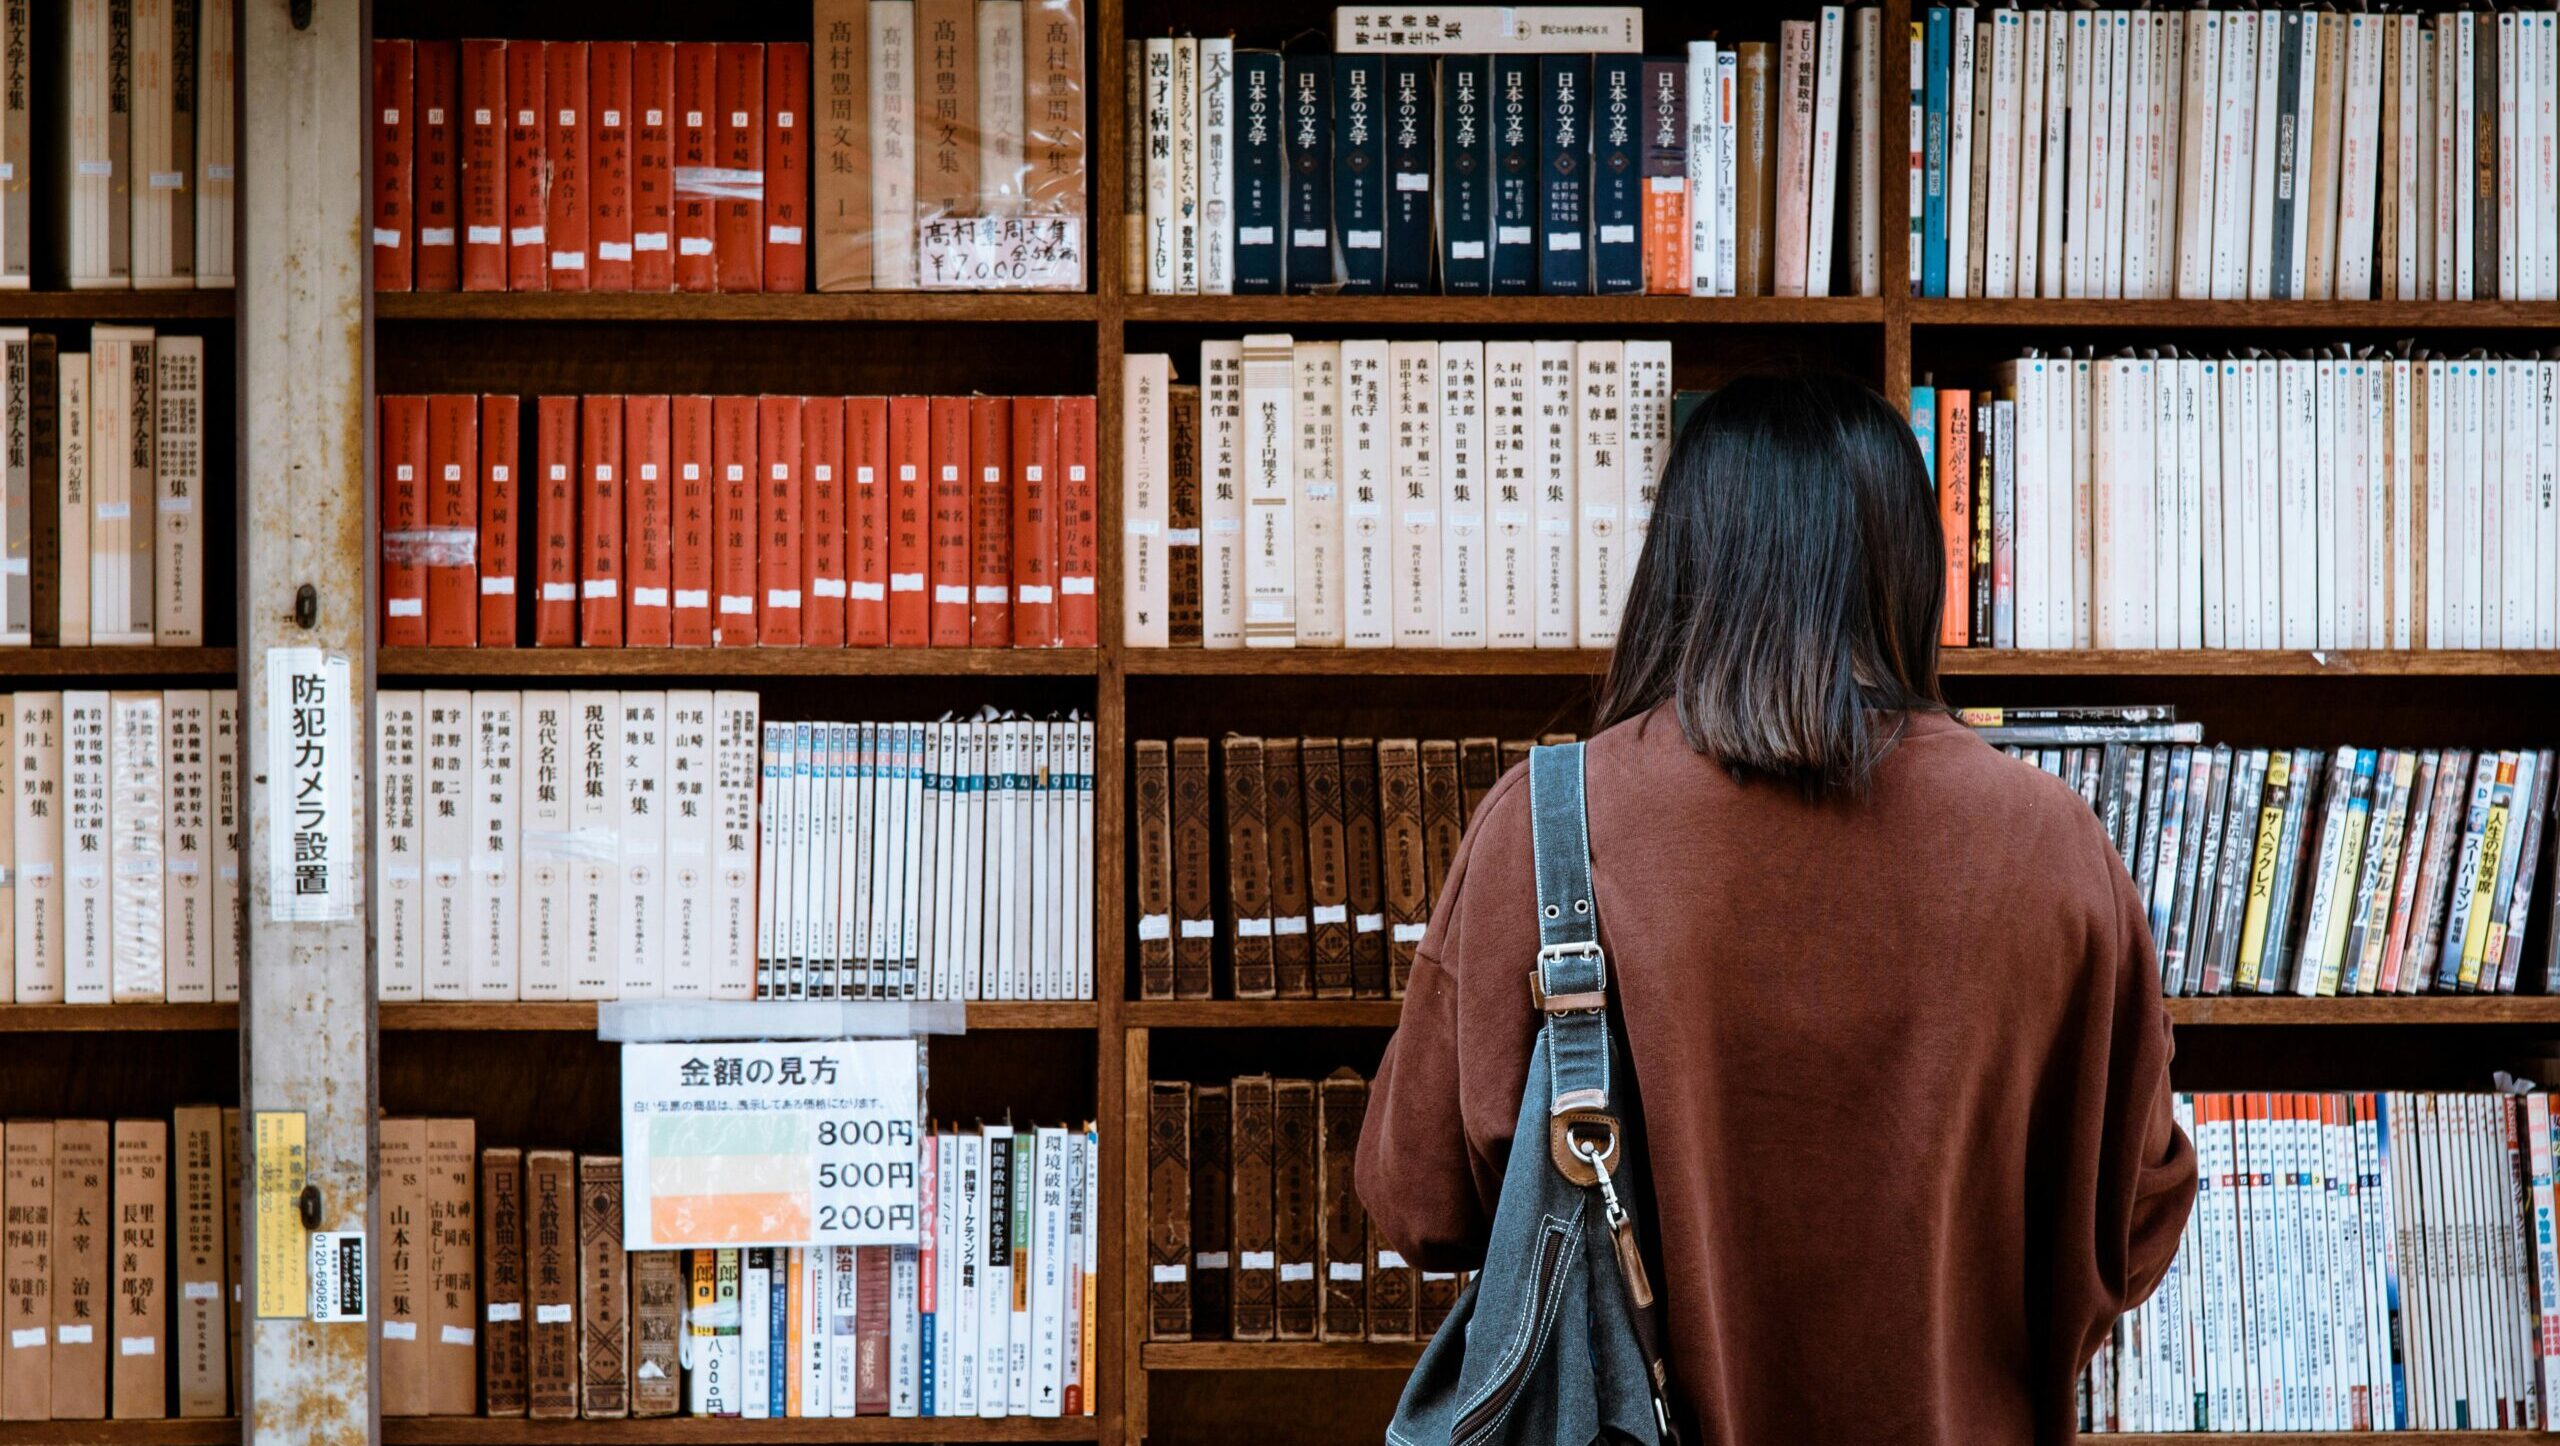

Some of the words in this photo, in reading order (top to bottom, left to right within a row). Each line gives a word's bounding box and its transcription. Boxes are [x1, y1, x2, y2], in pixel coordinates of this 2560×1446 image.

[1445, 22, 1463, 39] 集
[1151, 53, 1169, 159] 漫才病棟
[1201, 52, 1231, 127] 天才伝説
[1249, 70, 1267, 146] 日本の文学
[1298, 73, 1317, 148] 日本の文学
[1349, 70, 1368, 145] 日本の文学
[1399, 73, 1417, 148] 日本の文学
[1457, 72, 1475, 147] 日本の文学
[1505, 71, 1523, 147] 日本の文学
[1556, 72, 1574, 147] 日本の文学
[1609, 71, 1627, 147] 日本の文学
[1657, 73, 1675, 147] 日本の文学
[385, 129, 399, 216] 有島武郎
[561, 130, 576, 216] 宮本百合子
[613, 131, 625, 217] 岡本かの子
[779, 131, 794, 219] 井上靖
[1210, 134, 1223, 194] 横山やすし
[1303, 184, 1312, 222] 山本有三
[1156, 217, 1167, 278] ビートたけし
[1183, 225, 1194, 285] 春風亭昇太
[1210, 231, 1222, 280] 小林信彦
[8, 344, 25, 469] 昭和文学全集
[132, 344, 149, 469] 昭和文学全集
[1210, 359, 1223, 416] 遠藤周作
[1303, 361, 1315, 416] 木下順二
[1351, 360, 1363, 416] 宇野千代
[1366, 360, 1378, 416] 林芙美子
[1447, 359, 1458, 416] 岸田國士
[1463, 359, 1475, 416] 大佛次郎
[1511, 362, 1523, 417] 村山知義
[1542, 360, 1554, 416] 網野菊
[1588, 361, 1601, 446] 梅崎春生
[1604, 361, 1617, 446] 椎名麟三
[2186, 387, 2194, 422] ユリイカ
[2304, 389, 2312, 423] ユリイカ
[68, 442, 82, 504] 少年幻想曲
[1218, 422, 1232, 479] 井上光晴
[1262, 401, 1277, 488] 林芙美子・円地文子
[1359, 423, 1371, 480] 幸田文
[1418, 422, 1430, 477] 木下順二
[1496, 424, 1508, 480] 三好十郎
[1594, 450, 1612, 467] 集
[170, 479, 188, 498] 集
[1217, 483, 1233, 500] 集
[1358, 486, 1374, 503] 集
[1408, 482, 1424, 499] 集
[1454, 485, 1470, 501] 集
[1502, 485, 1519, 502] 集
[1547, 485, 1564, 502] 集
[493, 486, 507, 571] 大岡昇平
[597, 486, 611, 572] 堀辰雄
[685, 485, 699, 571] 山本有三
[729, 485, 743, 572] 石川達三
[773, 485, 788, 566] 横光利一
[816, 484, 831, 572] 室生犀星
[860, 486, 874, 572] 林芙美子
[902, 486, 915, 566] 舟橋聖一
[937, 486, 950, 572] 梅崎春生
[1028, 486, 1042, 572] 野間宏
[1065, 486, 1077, 572] 久保田万太郎
[1079, 486, 1091, 572] 佐藤春夫
[24, 709, 37, 794] 永井龍男
[40, 709, 53, 794] 井上靖
[90, 710, 103, 765] 岩野泡鳴
[385, 711, 397, 765] 小島信夫
[402, 711, 413, 765] 島尾敏雄
[448, 710, 460, 795] 宇野浩二
[482, 711, 494, 769] 伊藤左千夫
[499, 711, 511, 769] 正岡子規
[538, 711, 557, 802] 現代名作集
[585, 705, 604, 798] 現代名作集
[642, 708, 655, 792] 高見順
[676, 710, 689, 794] 中山義秀
[691, 710, 704, 794] 尾崎一雄
[30, 800, 48, 817] 集
[74, 773, 86, 829] 近松秋江
[173, 772, 186, 827] 桑原武夫
[189, 772, 202, 827] 中野好夫
[220, 772, 232, 826] 長谷川四郎
[292, 674, 328, 895] 防犯カメラ設置
[385, 774, 397, 828] 吉行淳之介
[402, 774, 413, 828] 安岡章太郎
[438, 800, 455, 817] 集
[631, 798, 648, 815] 集
[681, 800, 697, 817] 集
[928, 776, 936, 786] 5
[941, 779, 953, 789] 10
[990, 778, 998, 788] 3
[1005, 776, 1014, 788] 6
[1020, 779, 1029, 788] 4
[1053, 778, 1061, 788] 9
[1065, 777, 1076, 787] 11
[1081, 779, 1093, 789] 12
[81, 833, 98, 851] 集
[180, 833, 197, 851] 集
[391, 835, 407, 852] 集
[488, 835, 504, 852] 集
[728, 833, 744, 851] 集
[2254, 812, 2279, 897] ザ・ヘラクレス
[2375, 816, 2404, 891] キル・ビル
[2477, 812, 2503, 894] 人生の特等席
[2456, 838, 2479, 912] スーパーマン
[2452, 917, 2464, 944] 劇場版
[680, 1055, 840, 1087] 金額の見方
[818, 1120, 913, 1147] 800円
[31, 1176, 45, 1188] 64
[84, 1175, 98, 1187] 88
[141, 1167, 155, 1179] 50
[402, 1173, 417, 1185] 55
[453, 1173, 467, 1185] 91
[818, 1162, 913, 1189] 500円
[1044, 1136, 1061, 1206] 環境破壊
[1070, 1143, 1082, 1235] スポーツ科学概論
[819, 1204, 914, 1231] 200円
[963, 1170, 976, 1287] 損保マーケティング戦略
[992, 1142, 1006, 1262] 国際政治経済を学ぶ
[21, 1207, 34, 1296] 尾崎一雄
[445, 1201, 457, 1291] 丸岡明
[315, 1234, 328, 1319] 0120-690828
[446, 1292, 459, 1309] 集
[21, 1297, 34, 1316] 集
[129, 1297, 147, 1316] 集
